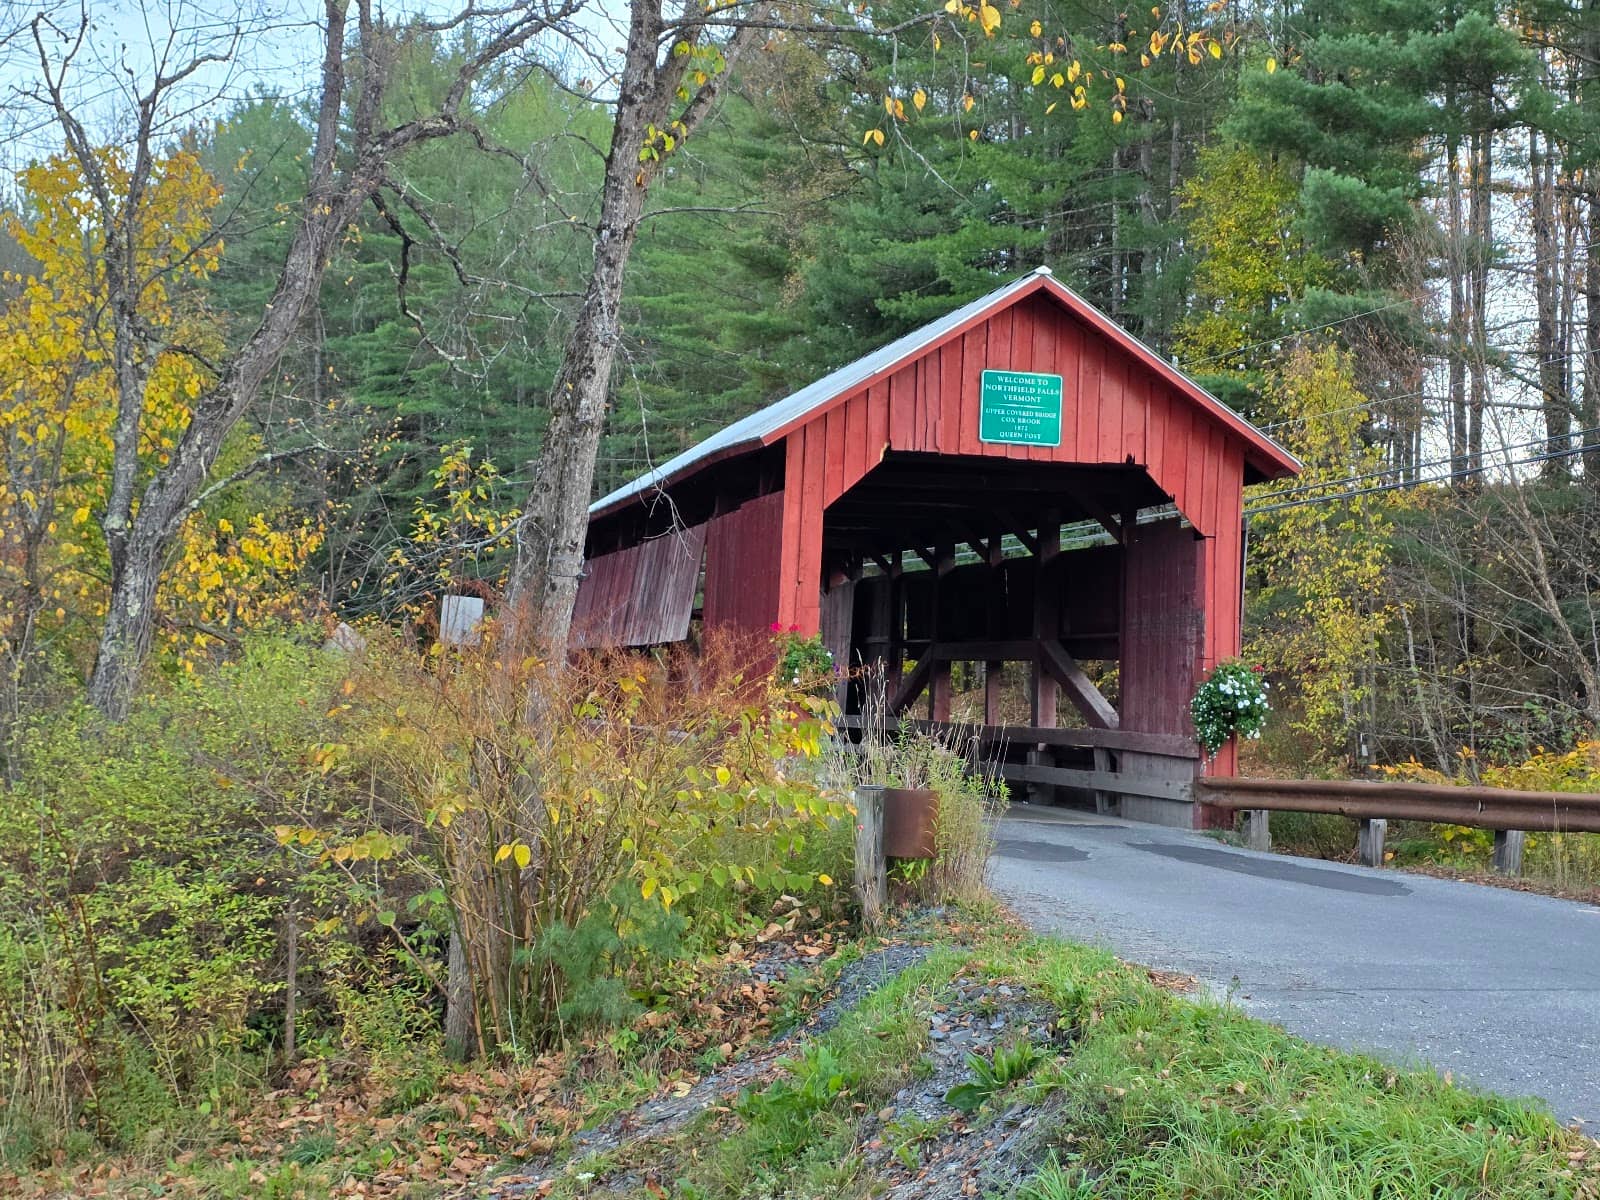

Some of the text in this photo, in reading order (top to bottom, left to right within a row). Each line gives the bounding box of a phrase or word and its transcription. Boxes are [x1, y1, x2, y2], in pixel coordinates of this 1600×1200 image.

[997, 375, 1049, 386] WELCOME TO
[985, 384, 1035, 394] NORTHFIELD
[1003, 394, 1041, 403] VERMONT
[1006, 409, 1034, 417] COVERED
[999, 431, 1022, 439] QUEEN
